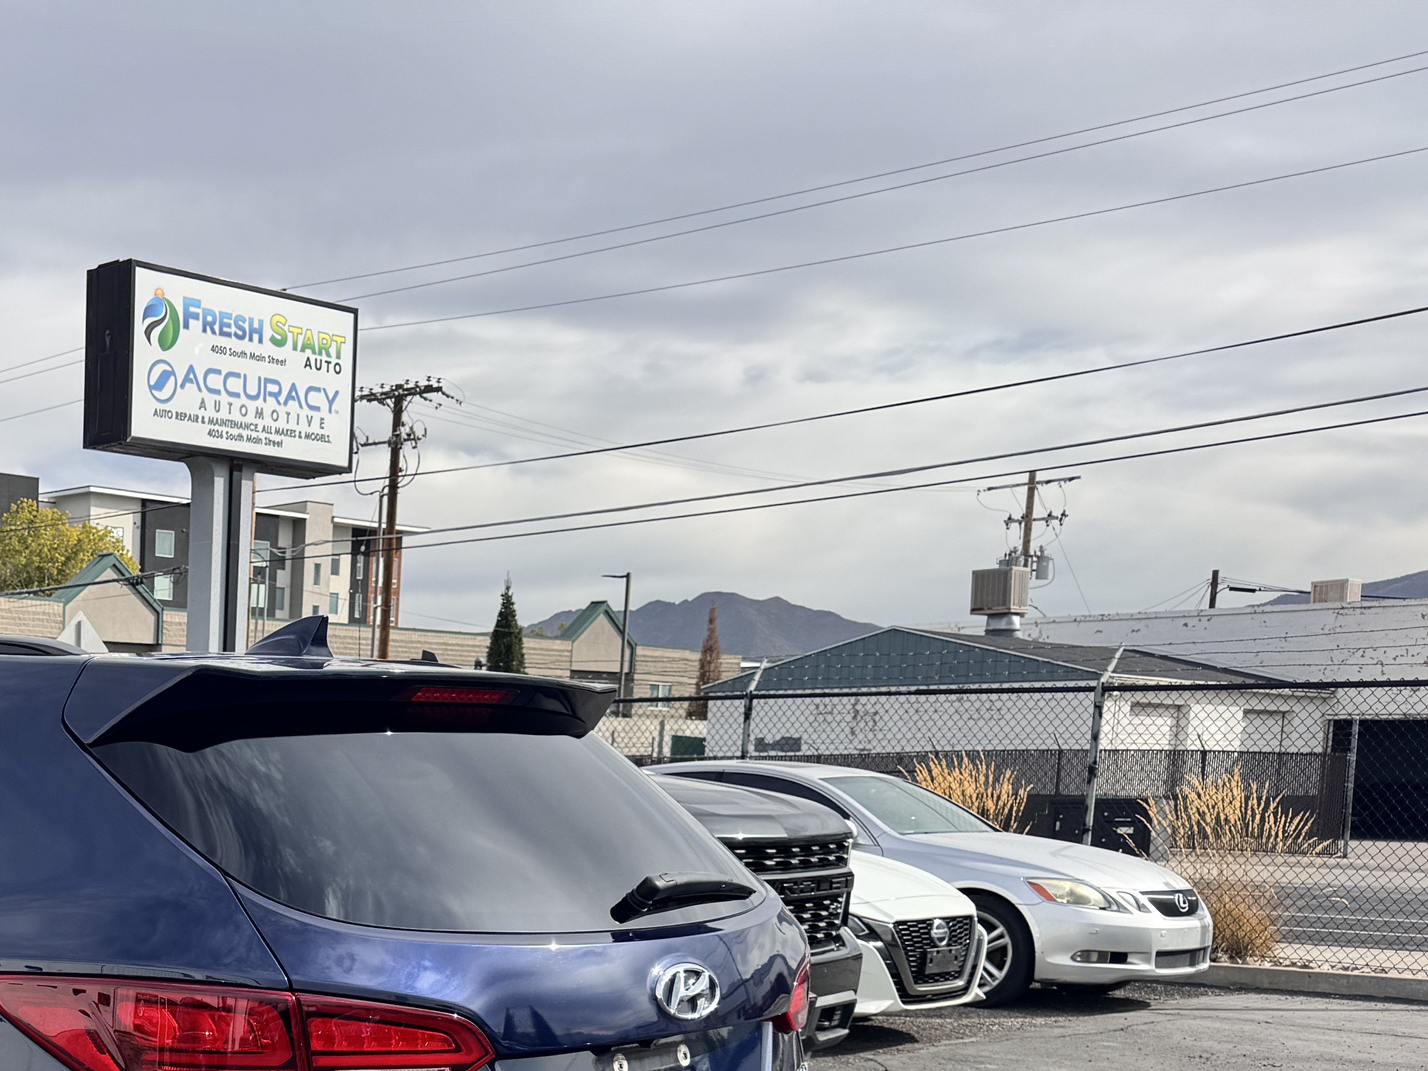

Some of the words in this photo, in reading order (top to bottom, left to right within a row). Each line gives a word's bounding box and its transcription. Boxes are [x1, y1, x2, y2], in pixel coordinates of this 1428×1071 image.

[182, 296, 265, 345] FRESH
[269, 313, 347, 361] START
[210, 344, 228, 356] 4050
[228, 347, 248, 360] South
[249, 351, 267, 364] Main
[267, 355, 287, 367] Street
[303, 356, 343, 375] AUTO
[179, 364, 340, 414] ACCURACY
[152, 408, 174, 420] AUTO
[174, 411, 200, 424] REPAIR
[200, 415, 206, 425] &
[261, 425, 273, 435] ALL
[274, 427, 297, 439] MAKES
[297, 430, 303, 439] &
[198, 397, 326, 430] AUTOMOTIVE
[207, 428, 224, 440] 4036
[225, 431, 245, 443] South
[245, 434, 263, 446] Main
[264, 436, 284, 449] Street
